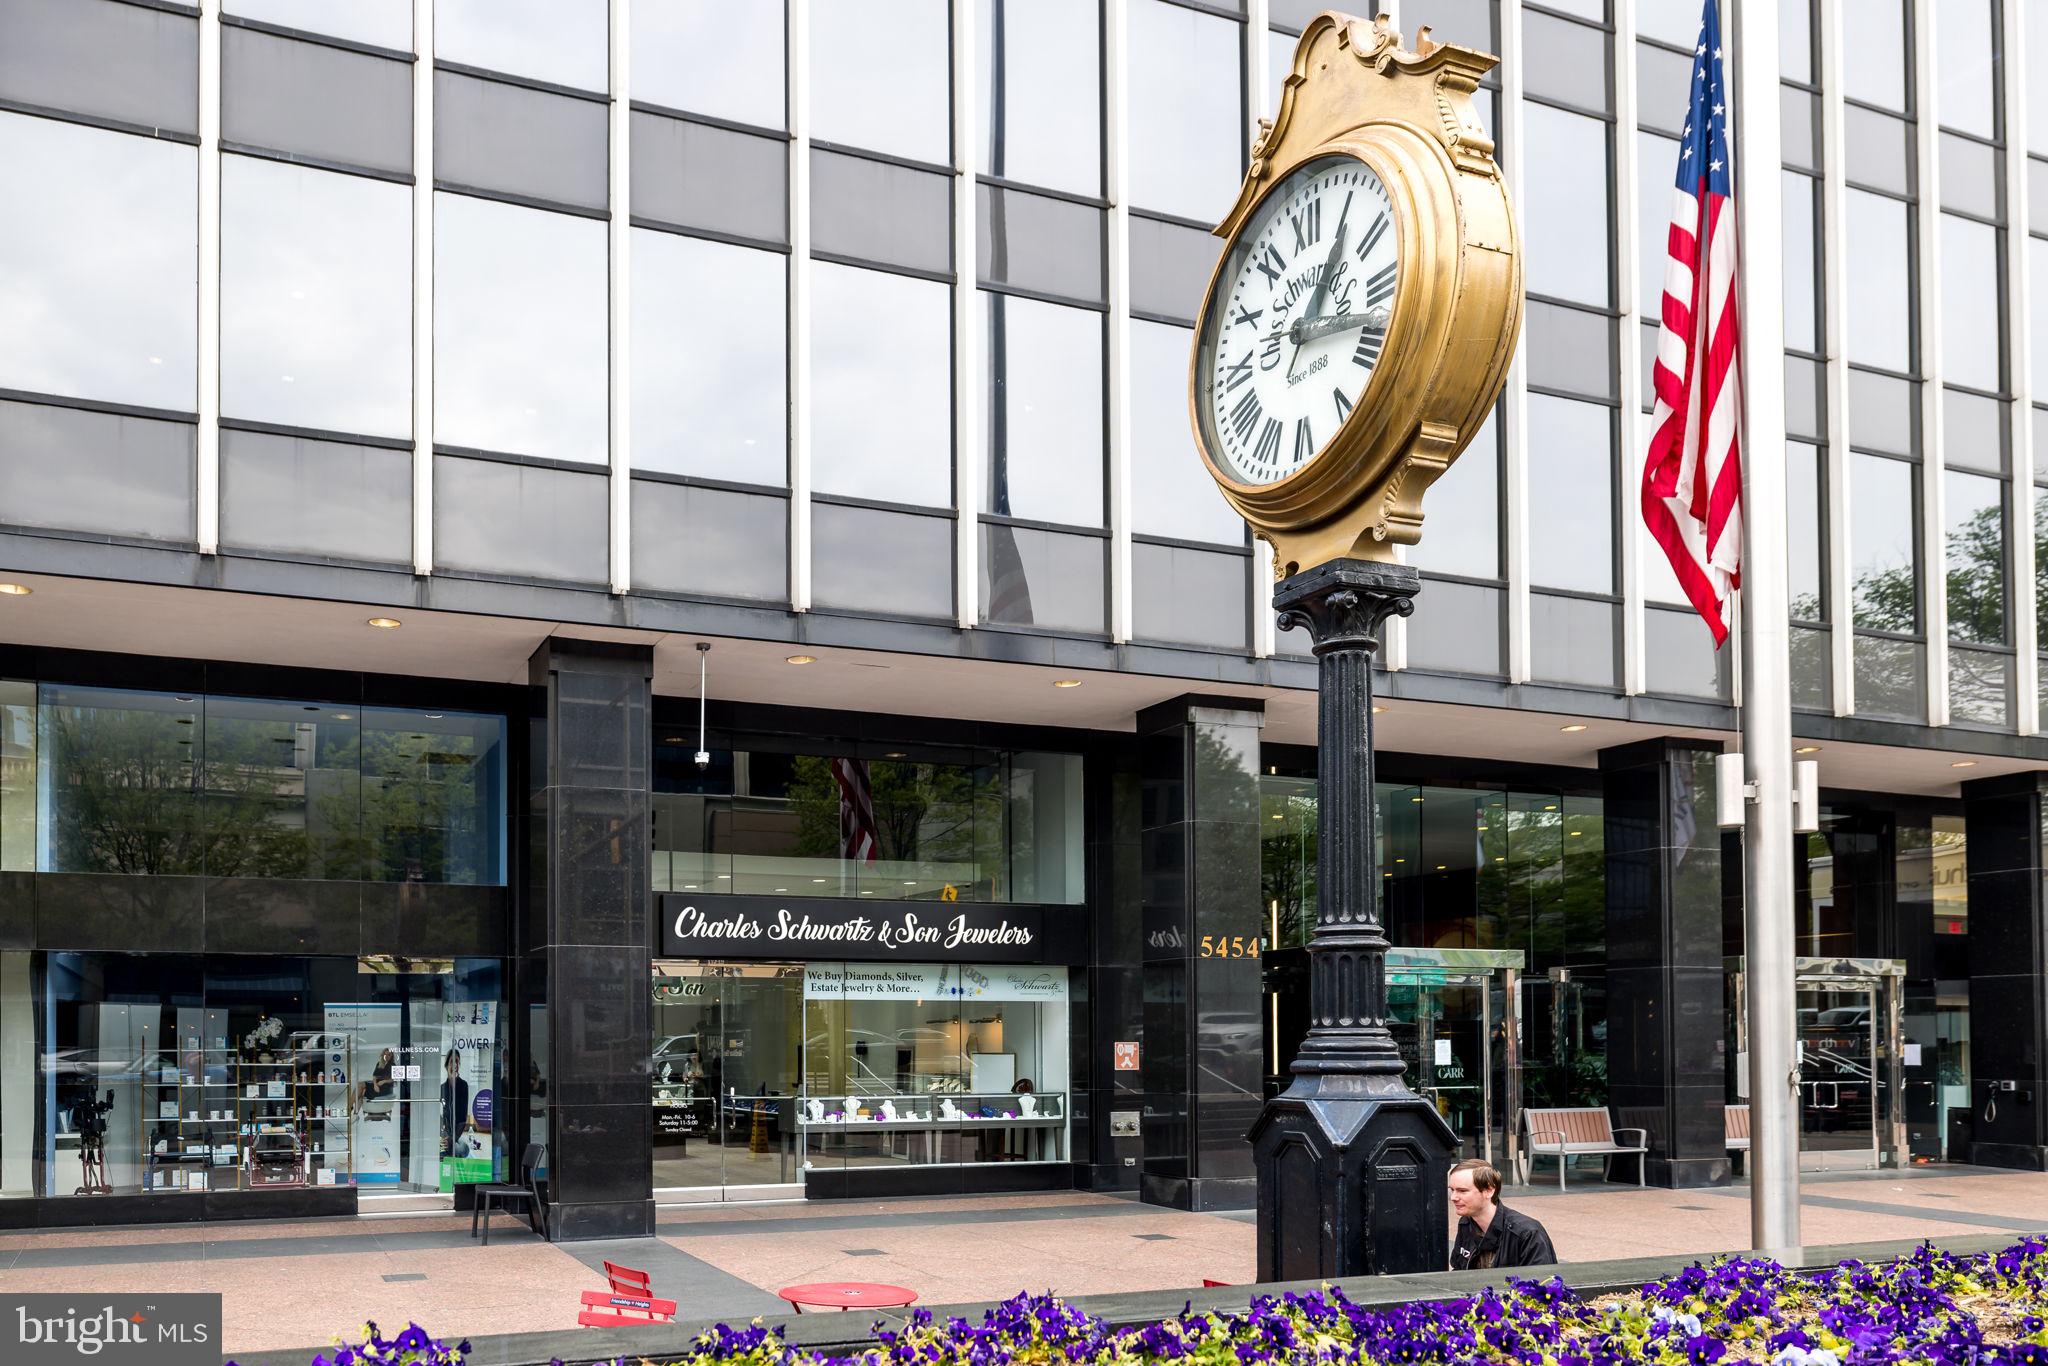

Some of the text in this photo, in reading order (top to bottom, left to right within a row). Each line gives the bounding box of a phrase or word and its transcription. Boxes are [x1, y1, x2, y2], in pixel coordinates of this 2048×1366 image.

[1291, 197, 1321, 258] XII
[1256, 242, 1287, 292] XI
[1329, 261, 1348, 296] &
[1272, 260, 1328, 317] Schwar
[1334, 278, 1357, 316] So
[1235, 304, 1264, 331] X
[1226, 348, 1254, 394] IX
[1309, 354, 1328, 376] 1888
[674, 906, 1034, 949] Charles Schwartz & Son Jewelers
[1200, 935, 1259, 958] 5454
[807, 971, 924, 983] We Buy Diamonds, Silver,
[810, 982, 839, 992] Estate
[840, 983, 874, 994] Jewelry
[876, 983, 884, 993] &
[1438, 1067, 1465, 1079] CARR
